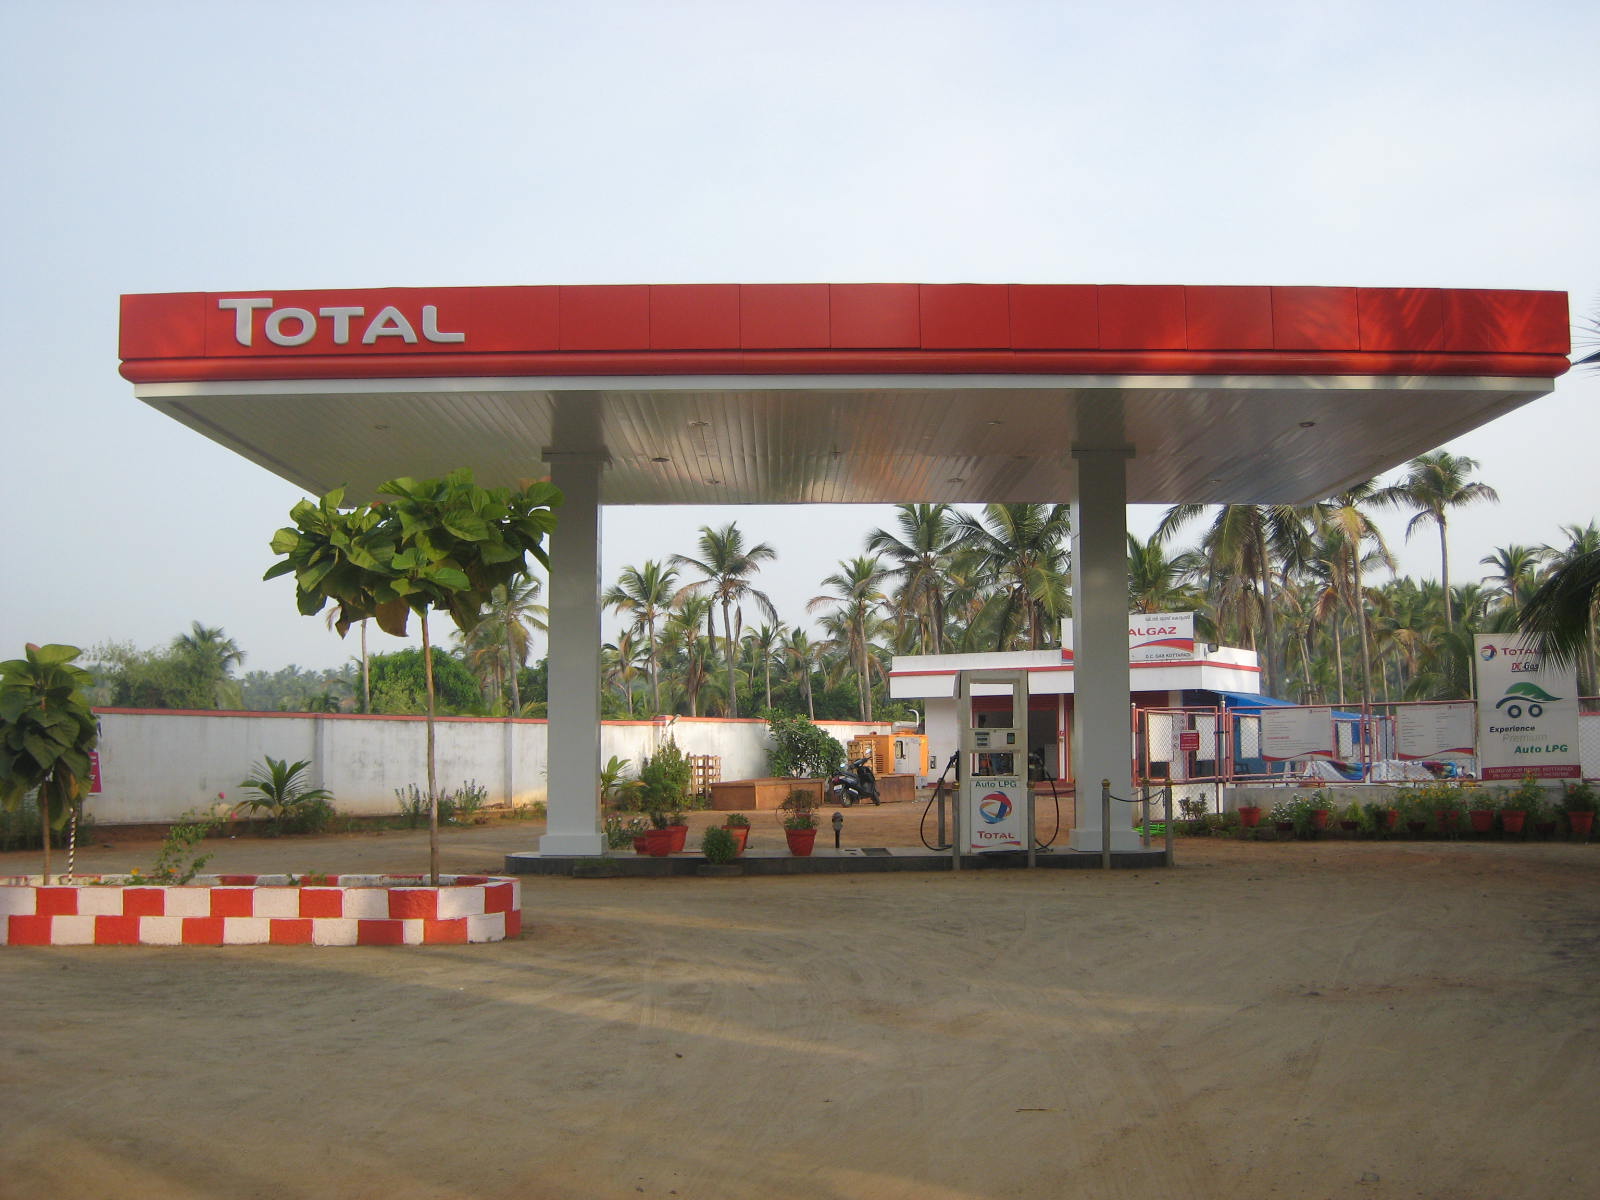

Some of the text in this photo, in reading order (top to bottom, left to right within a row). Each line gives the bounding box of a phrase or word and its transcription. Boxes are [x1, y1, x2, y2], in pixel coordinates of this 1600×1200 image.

[218, 298, 465, 346] TOTAL
[1489, 725, 1536, 734] Experience
[1514, 744, 1568, 754] Auto LPG
[975, 780, 1017, 788] Auto LPG
[976, 830, 1015, 840] TOTAL
